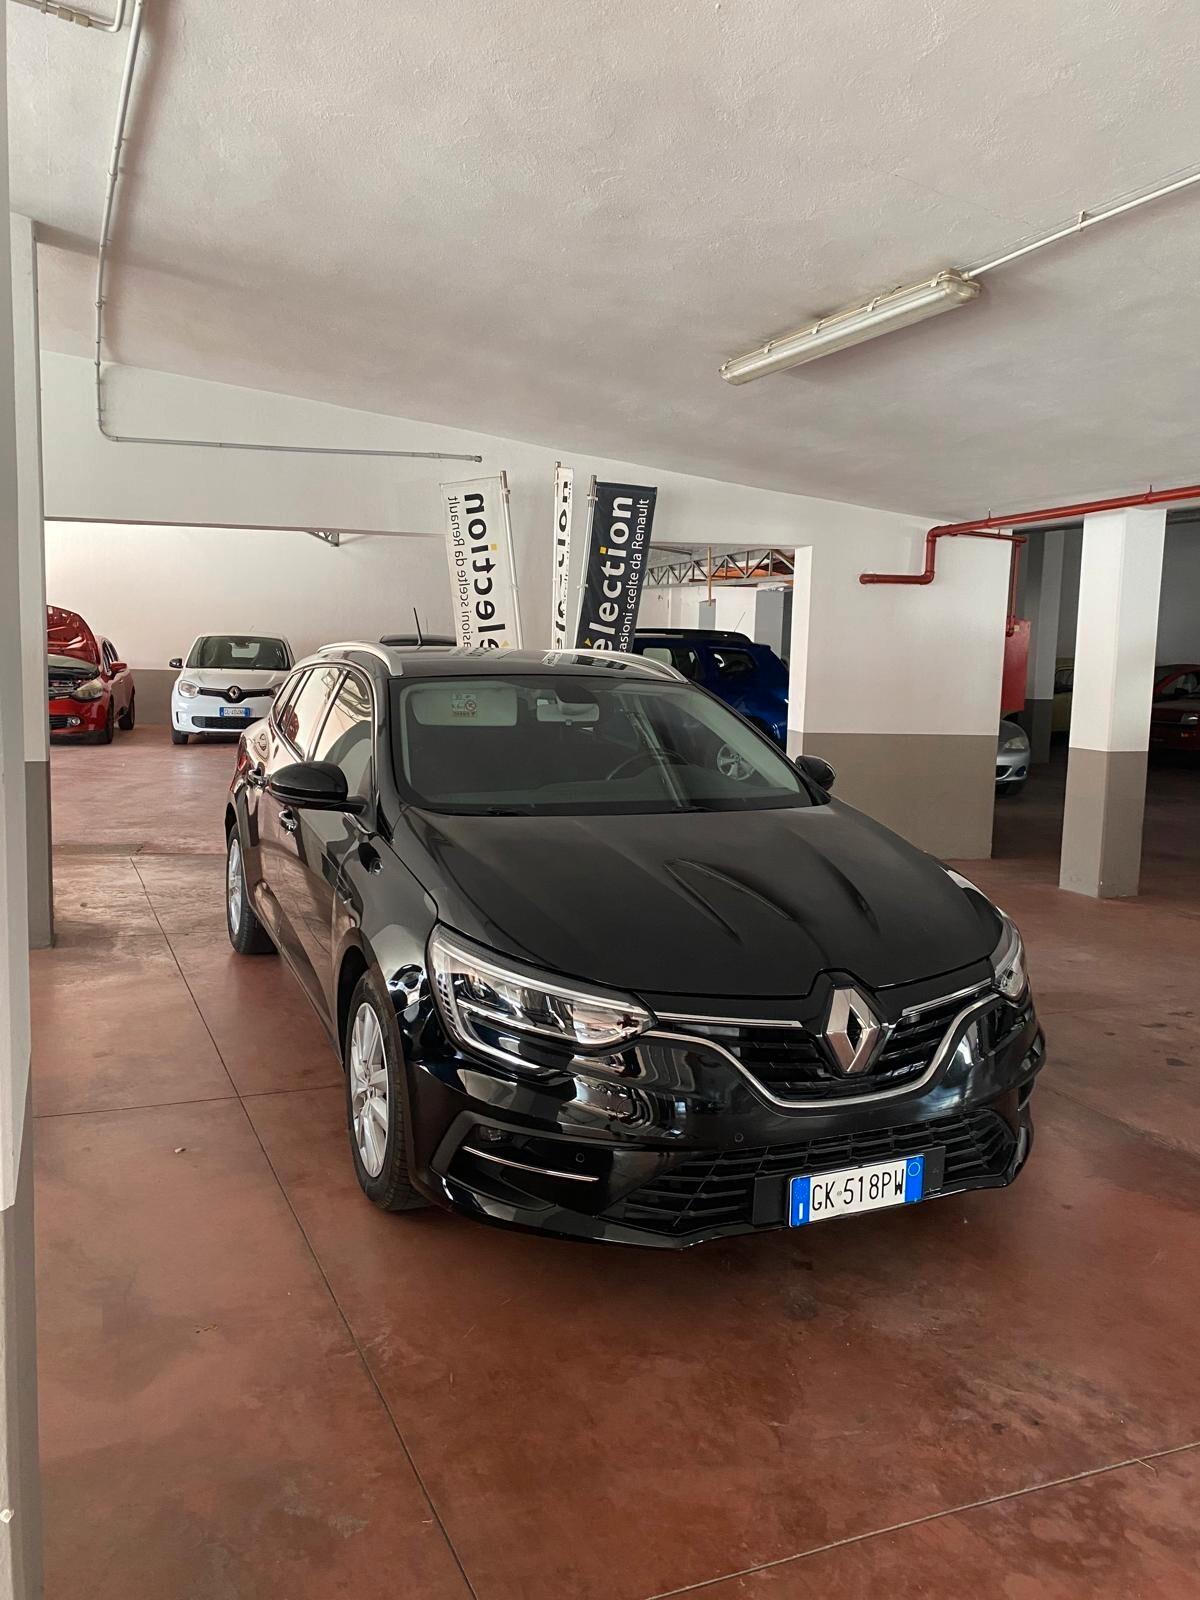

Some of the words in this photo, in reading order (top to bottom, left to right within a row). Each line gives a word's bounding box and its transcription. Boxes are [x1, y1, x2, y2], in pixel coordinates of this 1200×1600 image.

[631, 498, 650, 550] Renault
[629, 553, 642, 570] da
[625, 572, 639, 609] scelte
[619, 613, 634, 653] asioni
